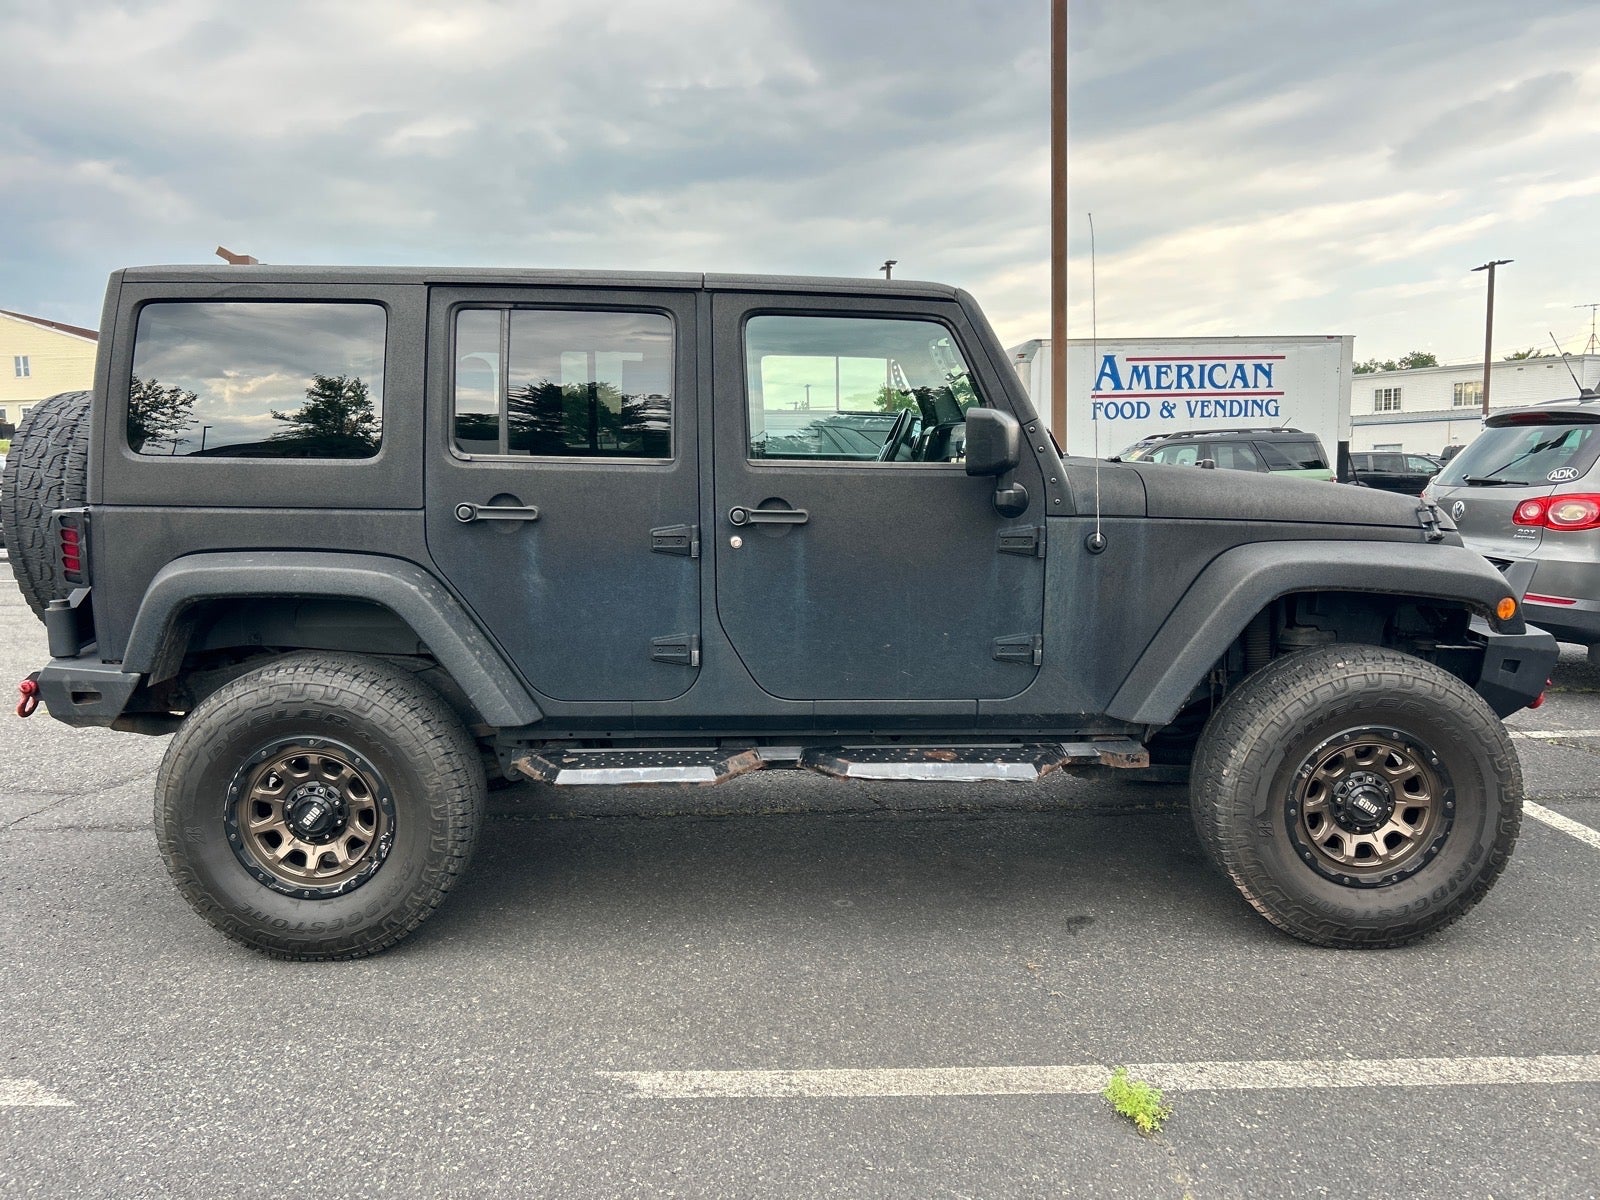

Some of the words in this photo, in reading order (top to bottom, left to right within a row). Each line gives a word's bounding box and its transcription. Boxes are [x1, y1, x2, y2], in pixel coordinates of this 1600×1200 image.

[1092, 354, 1274, 391] AMERICAN
[1091, 401, 1151, 420] FOOD
[1159, 400, 1176, 419] &
[1185, 398, 1280, 418] VENDING
[1551, 469, 1574, 479] ADK
[1358, 797, 1378, 814] GRID
[302, 806, 322, 826] GRID
